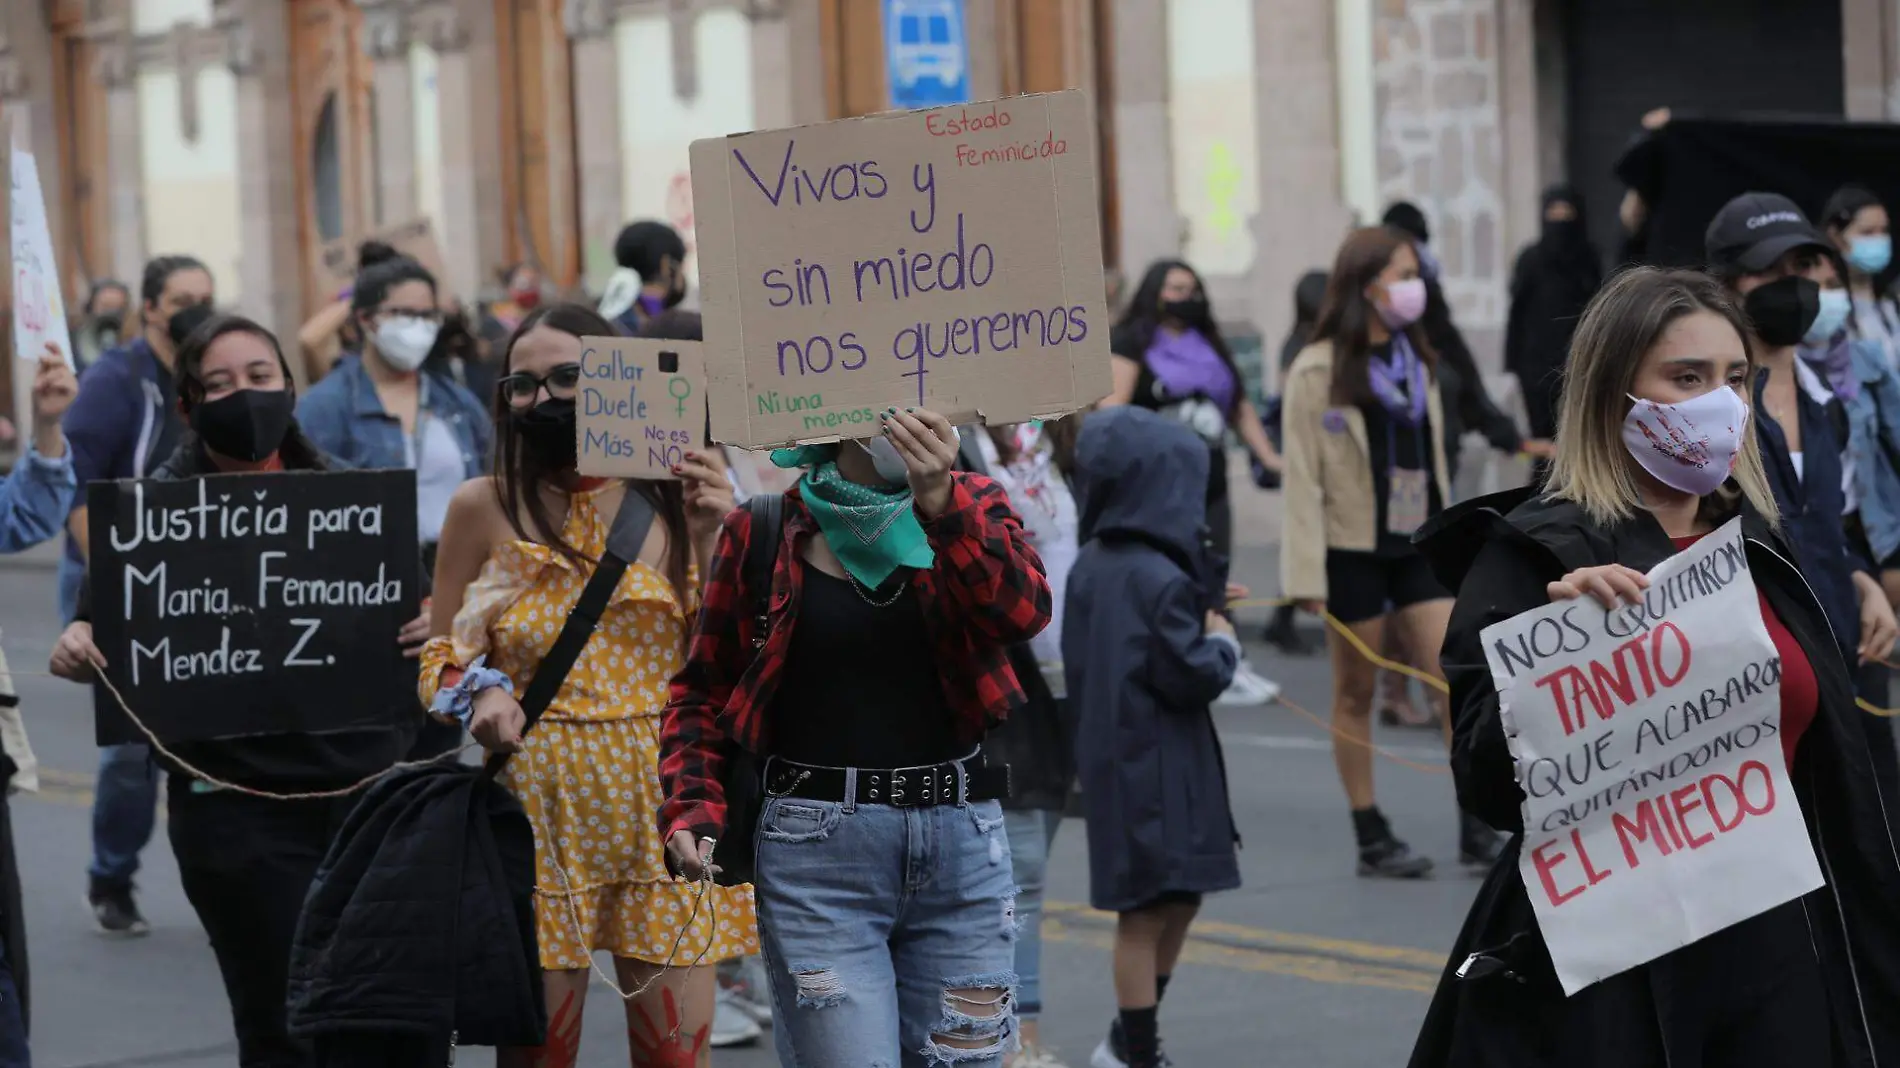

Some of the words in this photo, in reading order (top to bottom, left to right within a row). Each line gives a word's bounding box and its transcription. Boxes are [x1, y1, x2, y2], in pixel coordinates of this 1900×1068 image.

[926, 109, 1011, 137] Estado
[956, 131, 1068, 167] Feminicida
[733, 140, 888, 206] Vivas
[910, 162, 935, 232] y
[762, 258, 831, 306] sin
[853, 213, 994, 302] miedo
[581, 348, 644, 381] Callar
[777, 332, 868, 376] nos
[893, 305, 1088, 406] queremos
[583, 386, 647, 420] Duele
[645, 424, 665, 441] No
[670, 430, 690, 444] es
[757, 390, 781, 416] Ni
[785, 392, 822, 411] una
[804, 406, 875, 429] menos
[584, 427, 634, 458] Más
[648, 444, 682, 468] NO
[110, 478, 288, 551] Justicia
[308, 504, 382, 550] para
[124, 561, 229, 618] Maria
[258, 551, 401, 609] Fernanda
[1494, 605, 1591, 678] NOS
[1604, 535, 1747, 638] QUITARON
[131, 626, 263, 686] Mendez
[283, 618, 335, 667] Z.
[1535, 621, 1692, 736] TANTO
[1528, 730, 1622, 797] QUE
[1542, 716, 1777, 832] QUITÁNDONOS
[1531, 828, 1612, 907] EL
[1612, 760, 1776, 869] MIEDO
